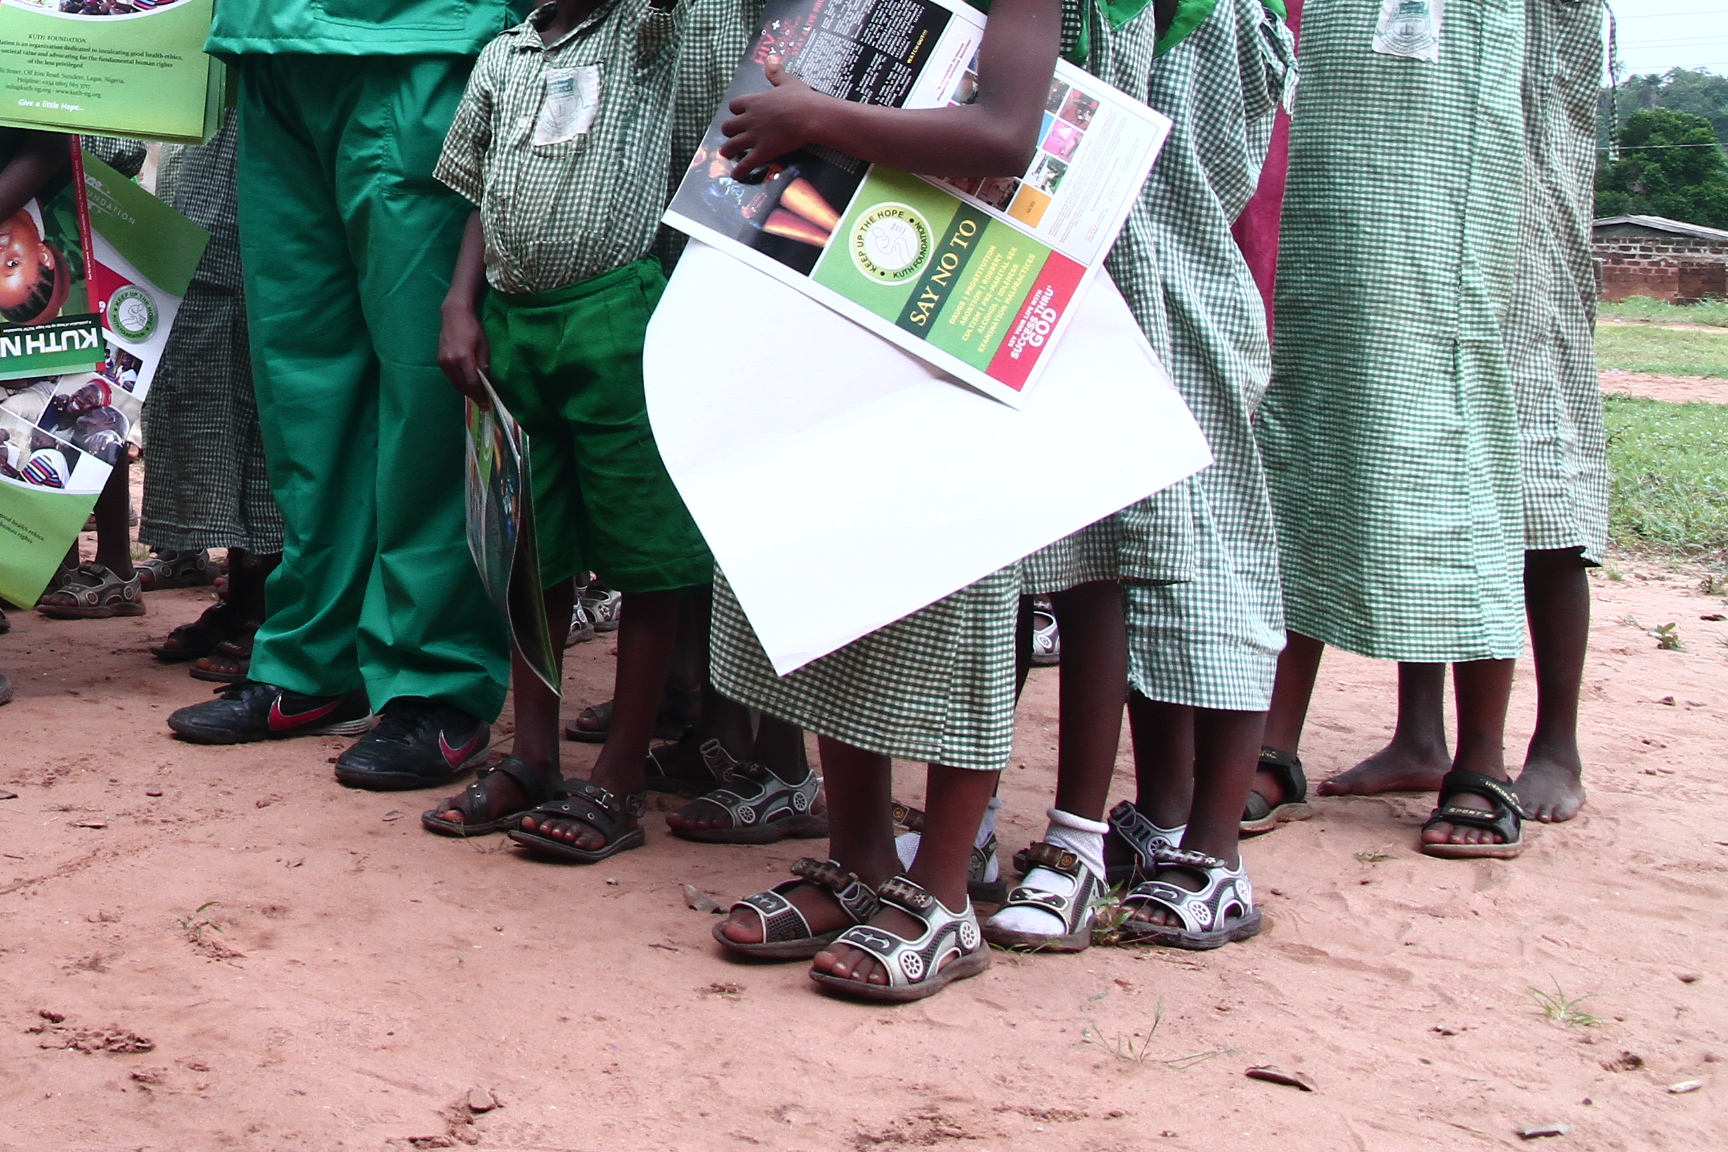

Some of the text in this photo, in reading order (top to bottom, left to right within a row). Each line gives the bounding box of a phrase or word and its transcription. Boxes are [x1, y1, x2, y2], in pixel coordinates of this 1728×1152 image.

[47, 35, 86, 43] FOUNDATION
[63, 44, 90, 52] dedicated
[754, 33, 774, 64] HIV
[790, 36, 804, 56] STAY
[799, 12, 818, 36] ALIVE
[906, 45, 918, 63] WATCH
[98, 56, 134, 64] fundamental
[18, 98, 33, 106] Give
[42, 100, 58, 108] little
[83, 189, 135, 224] UNDATION
[857, 210, 904, 273] KEEP UP THE HOPE
[893, 222, 927, 278] KUTH FOUNDATION
[910, 218, 976, 325] SAY NO TO
[948, 245, 995, 324] DRUGS PROSTITUTION
[959, 253, 1001, 325] ABORTION ROBBERY
[961, 246, 1017, 340] CULTISM PRE-MARITAL SEX
[977, 263, 1018, 333] ALCOHOL IDLENESS
[977, 253, 1034, 352] EXAMINATION MALPRACTICES
[1007, 289, 1042, 347] KEY YOUR LIFE WITH
[1010, 285, 1053, 358] SUCCESS THRU'
[25, 327, 97, 354] KUTH
[1028, 308, 1056, 346] GOD
